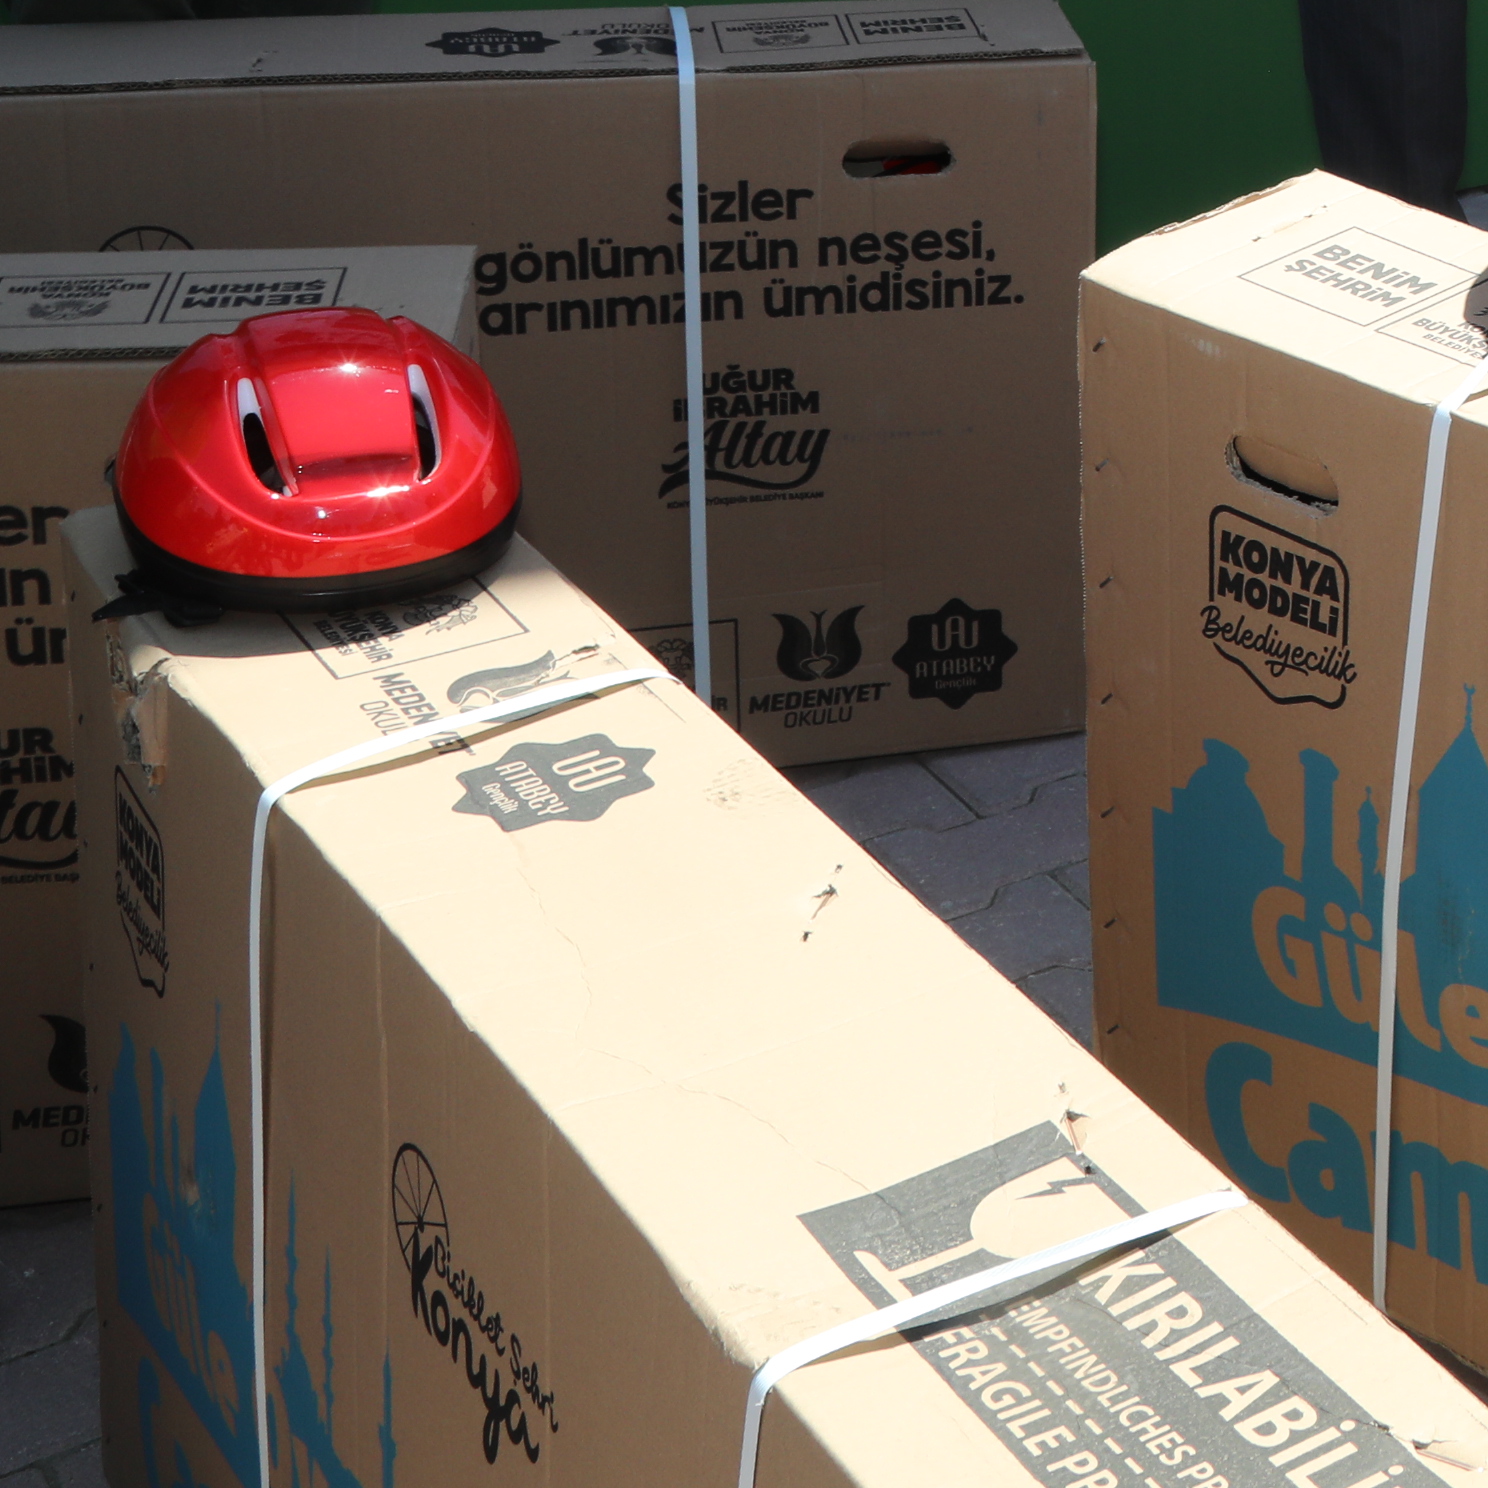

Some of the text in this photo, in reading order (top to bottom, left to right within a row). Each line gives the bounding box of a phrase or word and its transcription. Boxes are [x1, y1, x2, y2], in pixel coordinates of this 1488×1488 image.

[818, 219, 996, 270] neşesi,
[478, 268, 1025, 337] arınımızın ümidisiniz.
[672, 390, 820, 422] İRAHİM
[1216, 565, 1340, 638] MODELİ
[1219, 529, 1341, 603] KONYA
[915, 655, 997, 680] ATABEY
[1200, 604, 1358, 685] Belediyecilik
[783, 705, 854, 729] OKULU
[411, 1224, 540, 1465] Konya
[922, 1324, 1078, 1459] FRAGILE
